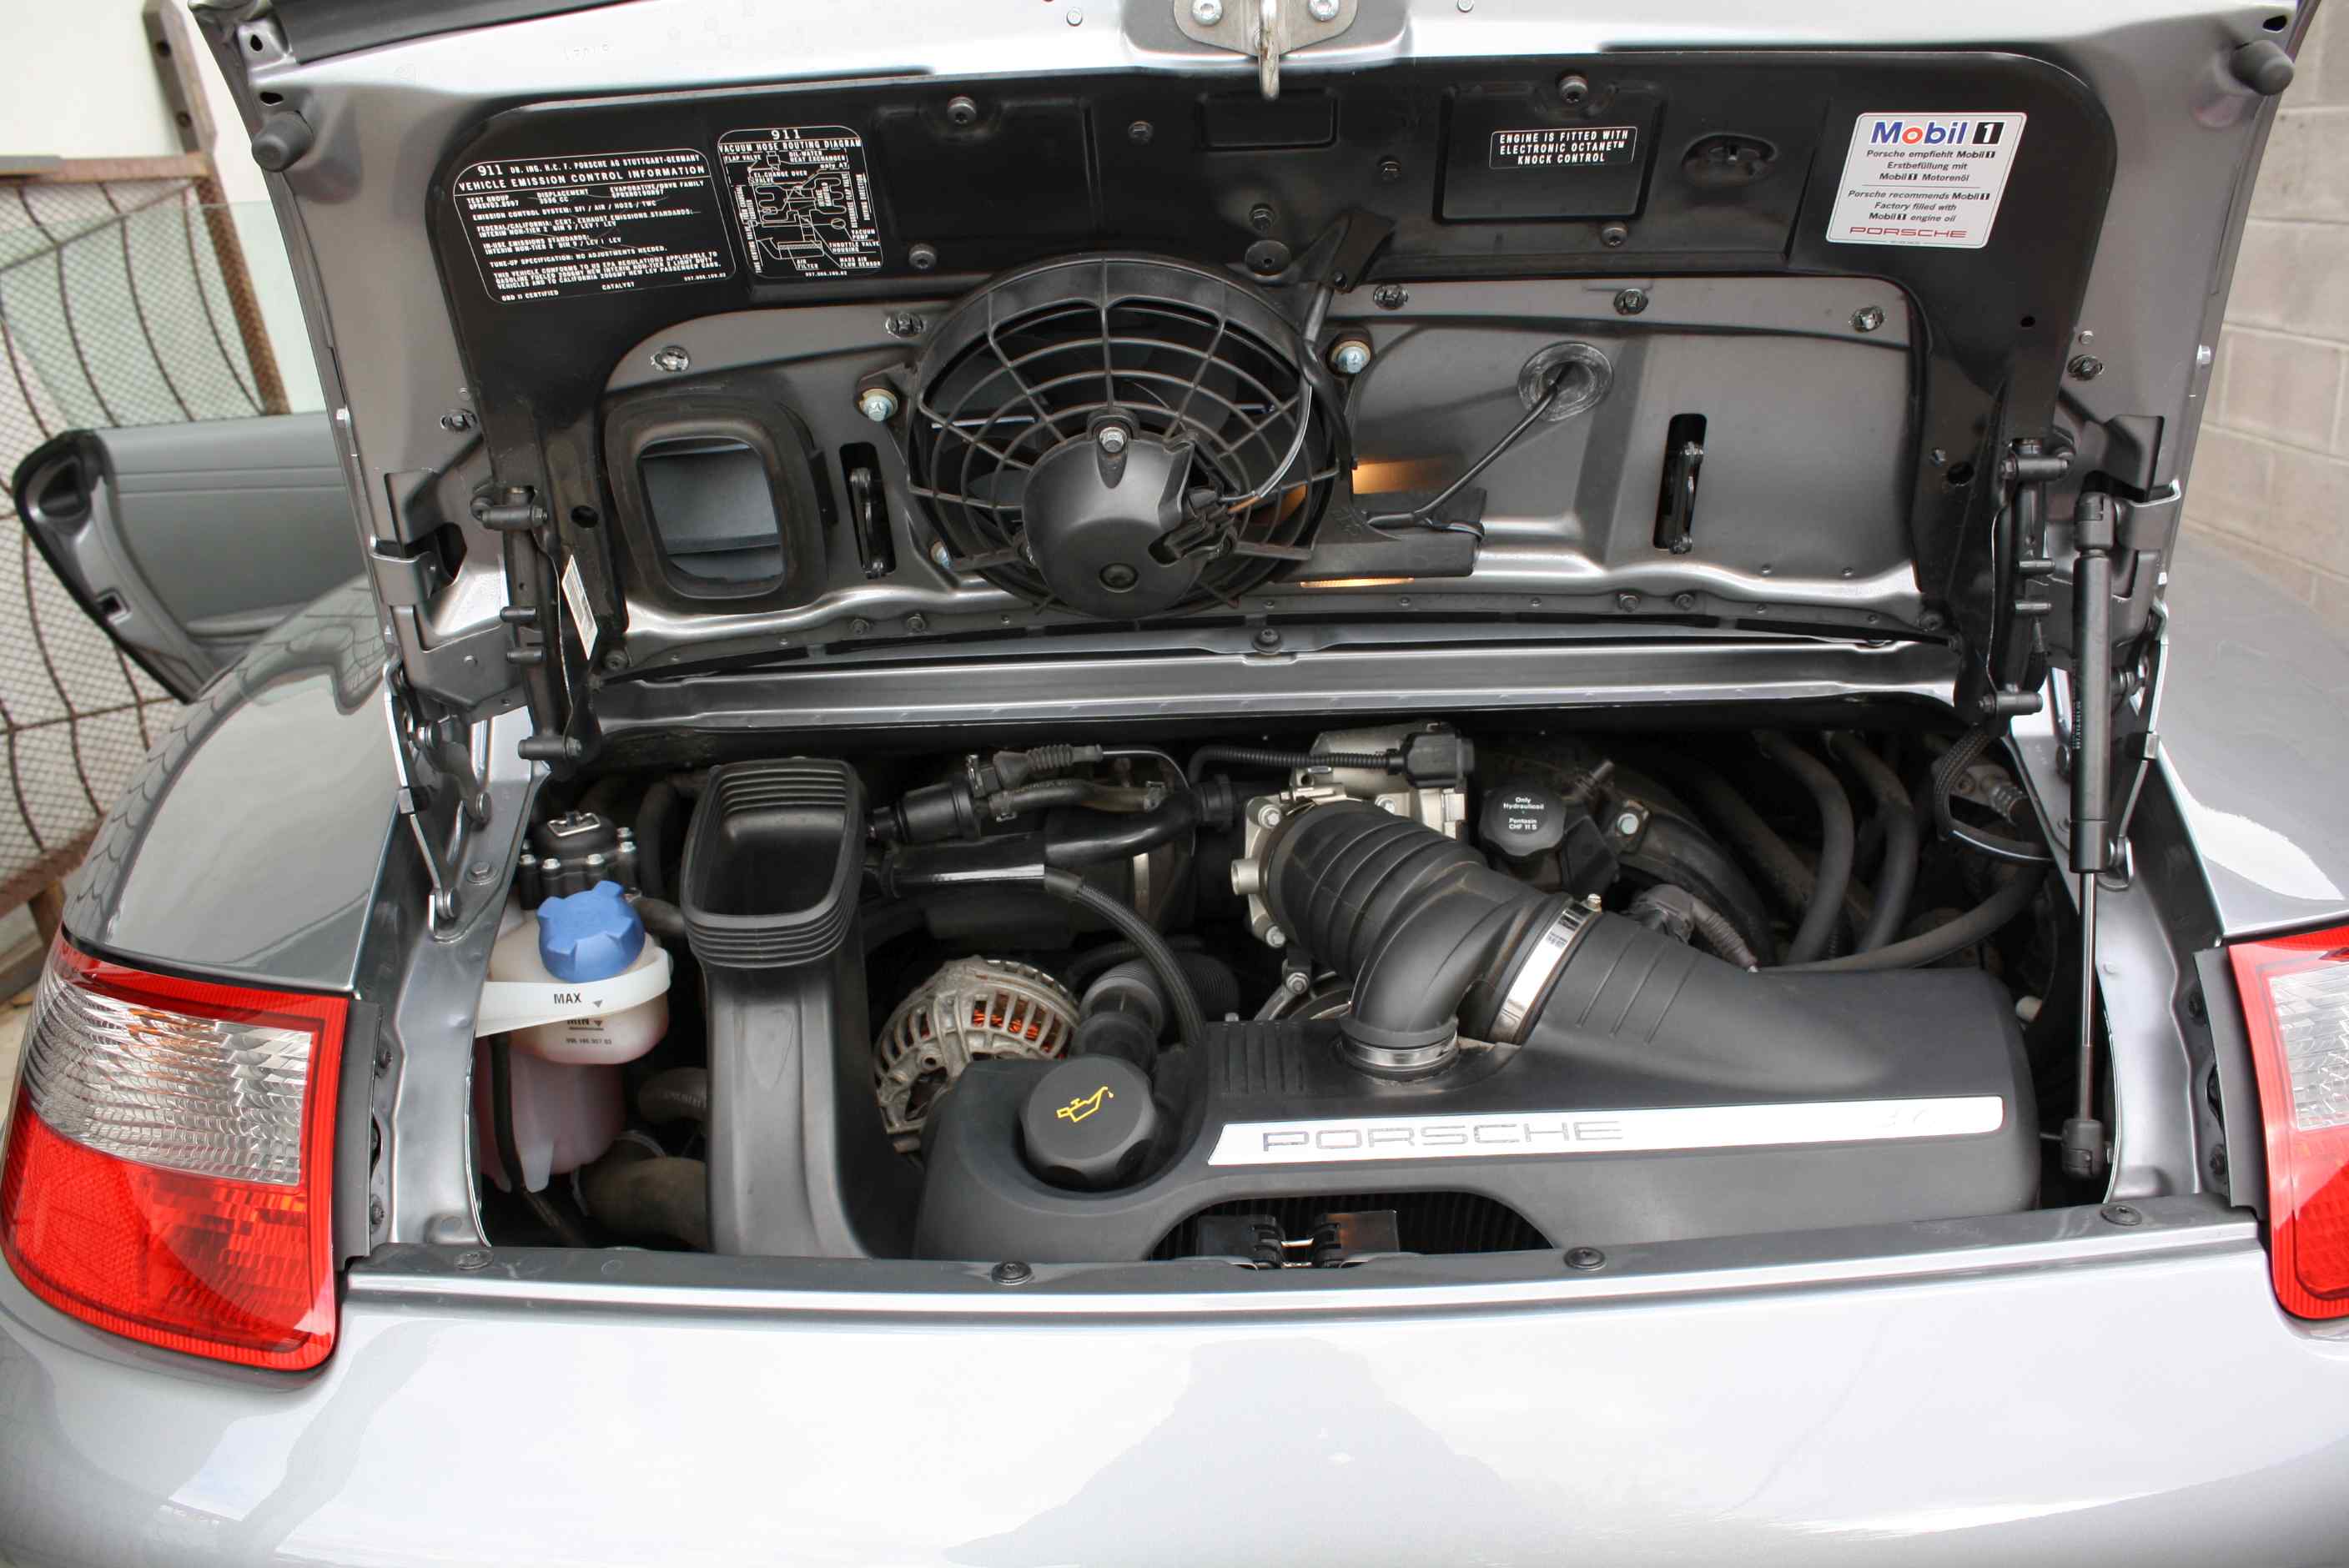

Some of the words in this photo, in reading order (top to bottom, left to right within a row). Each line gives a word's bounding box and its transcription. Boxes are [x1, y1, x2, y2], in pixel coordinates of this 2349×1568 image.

[771, 129, 801, 140] 911
[1500, 133, 1539, 144] ENGINE
[1544, 133, 1555, 142] IS
[1560, 132, 1597, 142] FITTED
[1602, 130, 1628, 140] WITH
[1871, 121, 1968, 144] Mobil
[718, 143, 752, 153] VACUUM
[756, 143, 778, 151] HOSE
[782, 141, 820, 149] ROUTING
[823, 138, 861, 148] DIAGRAM
[1500, 143, 1567, 155] ELECTRONIC
[1517, 155, 1552, 165] KNOCK
[1557, 153, 1605, 163] CONTROL
[1909, 150, 1954, 159] empfiehlt
[475, 164, 502, 176] 911
[572, 159, 607, 169] PORSCHE
[1887, 162, 1949, 170] Erstbefüllung
[457, 179, 506, 191] VEHICLE
[510, 175, 566, 188] EMISSION
[569, 171, 622, 183] CONTROL
[626, 164, 705, 178] INFORMATION
[1922, 173, 1970, 182] Motorenöl
[536, 188, 589, 199] DISPLACEMENT
[1874, 202, 1911, 211] Factory
[1912, 203, 1936, 211] filled
[471, 212, 506, 220] EMISSION
[506, 209, 540, 218] CONTROL
[576, 215, 608, 224] EXHAUST
[609, 212, 648, 221] EMISSIONS
[1910, 215, 1942, 224] engine
[477, 229, 507, 238] INTERIM
[1849, 226, 1968, 239] PORSCHE
[506, 238, 546, 246] EMISSIONS
[586, 249, 636, 259] ADJUSTMENTS
[509, 267, 540, 275] VEHICLE
[540, 264, 578, 273] CONFORMS
[616, 256, 664, 266] REGULATIONS
[665, 252, 706, 261] APPLICABLE
[494, 274, 528, 283] GASOLINE
[602, 264, 631, 273] INTERIM
[495, 279, 530, 289] VEHICLES
[557, 274, 598, 283] CALIFORNIA
[659, 264, 699, 273] PASSENGER
[601, 281, 635, 290] CATALYST
[523, 289, 559, 298] CERTIFIED
[553, 993, 582, 1005] MAX
[1262, 1120, 1623, 1153] PORSCHE
